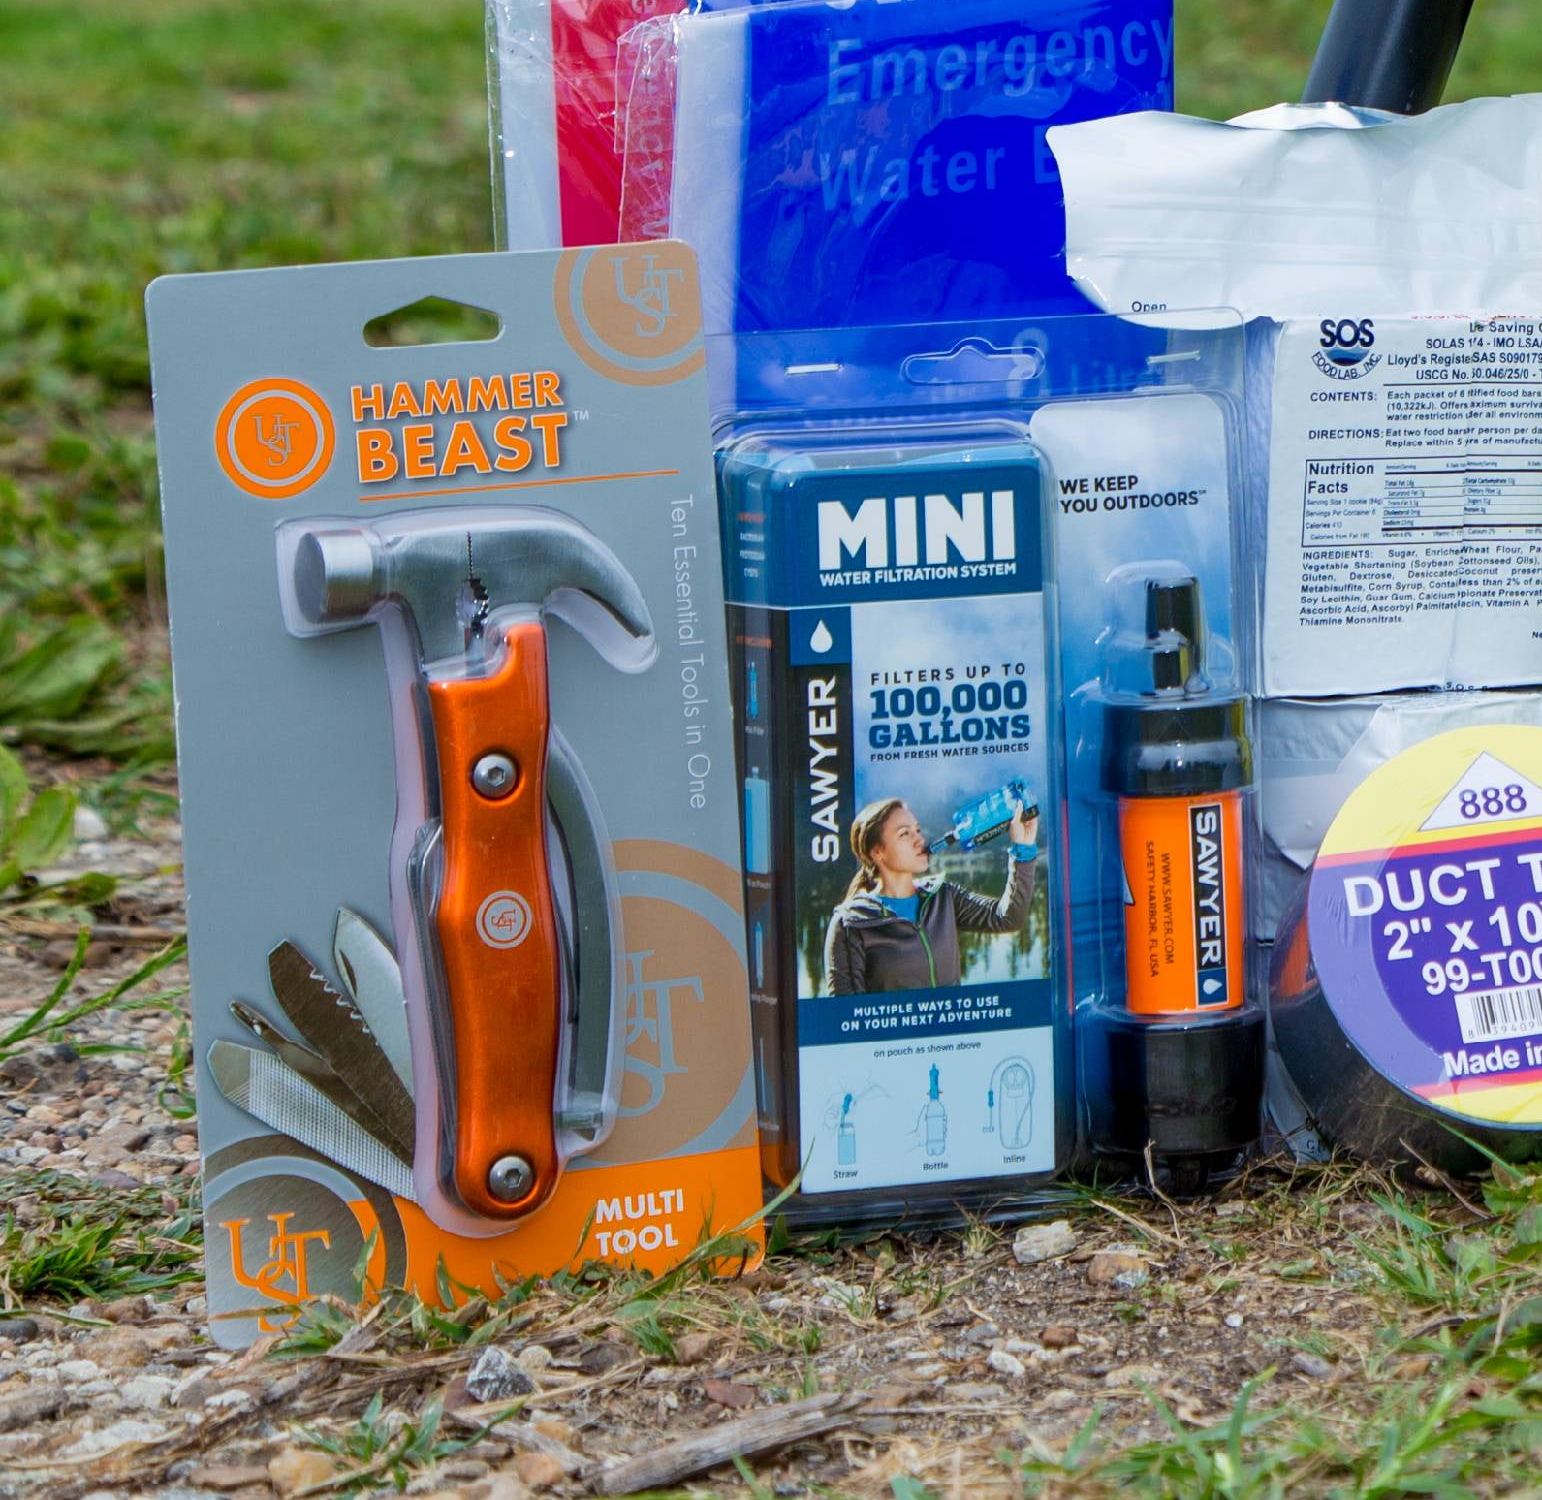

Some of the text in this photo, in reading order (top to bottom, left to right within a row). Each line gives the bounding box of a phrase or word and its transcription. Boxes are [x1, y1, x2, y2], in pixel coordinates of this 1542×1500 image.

[826, 16, 1172, 105] Emergency
[818, 139, 1006, 213] Water
[1320, 319, 1375, 348] SOS
[1489, 322, 1534, 334] Saving
[1426, 338, 1465, 348] SOLAS
[1387, 354, 1427, 366] Lloyd's
[1416, 370, 1449, 380] USCG
[350, 371, 566, 422] HAMMER
[1310, 392, 1377, 401] CONTENTS:
[1387, 391, 1407, 399] Each
[1308, 429, 1384, 439] DIRECTIONS:
[355, 412, 568, 484] BEAST
[1309, 463, 1374, 476] Nutrition
[1059, 475, 1140, 495] WE KEEP
[1307, 481, 1348, 494] Facts
[1060, 496, 1097, 514] YOU
[817, 490, 1016, 571] MINI
[1303, 550, 1374, 560] INGREDIENTS:
[820, 562, 1017, 587] WATER FILTRATION SYSTEM
[671, 494, 711, 809] Ten Essential Tools in One
[871, 663, 1025, 685] FILTERS UP TO
[870, 680, 1027, 721] 100,000
[869, 714, 1030, 749] GALLONS
[870, 743, 1029, 762] FROM FRESH WATER SOURCES
[808, 676, 840, 863] SAWYER
[1458, 783, 1528, 820] 888
[1196, 811, 1222, 966] SAWYER
[1342, 858, 1501, 917] DUCT
[1146, 841, 1159, 978] SAFETY USA
[1161, 852, 1174, 965] WWW.SAWYER.COM
[1383, 916, 1432, 961] 2"
[1446, 920, 1478, 953] x
[854, 996, 999, 1017] MULTIPLE WAYS TO USE
[841, 1008, 1012, 1032] ON YOUR NEXT ADVENTURE
[887, 1042, 981, 1058] pouch shown above
[1443, 1045, 1520, 1076] Made
[922, 1160, 950, 1171] Bottle
[1003, 1152, 1027, 1164] Inline
[833, 1168, 859, 1180] Straw
[595, 1188, 685, 1224] MULTI
[596, 1224, 680, 1258] TOOL
